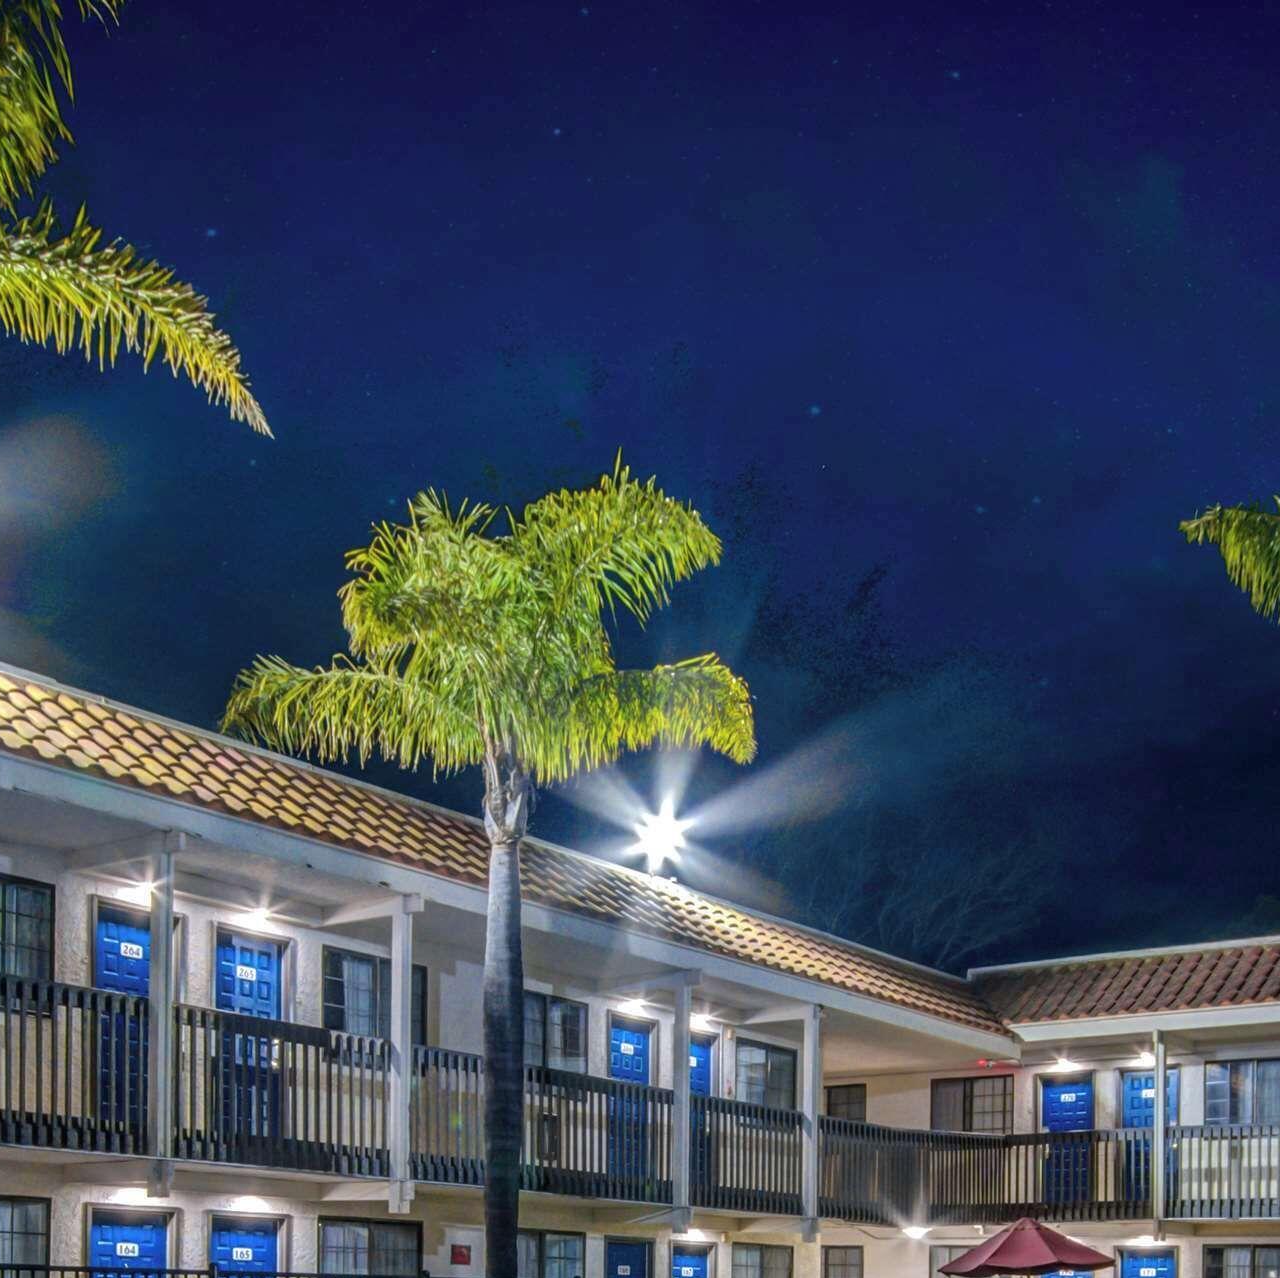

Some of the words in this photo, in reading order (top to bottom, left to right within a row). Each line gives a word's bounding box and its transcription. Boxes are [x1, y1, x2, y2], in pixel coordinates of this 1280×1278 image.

[122, 944, 141, 957] 264
[238, 967, 255, 979] 265
[118, 1244, 137, 1256] 164
[234, 1249, 250, 1260] 165
